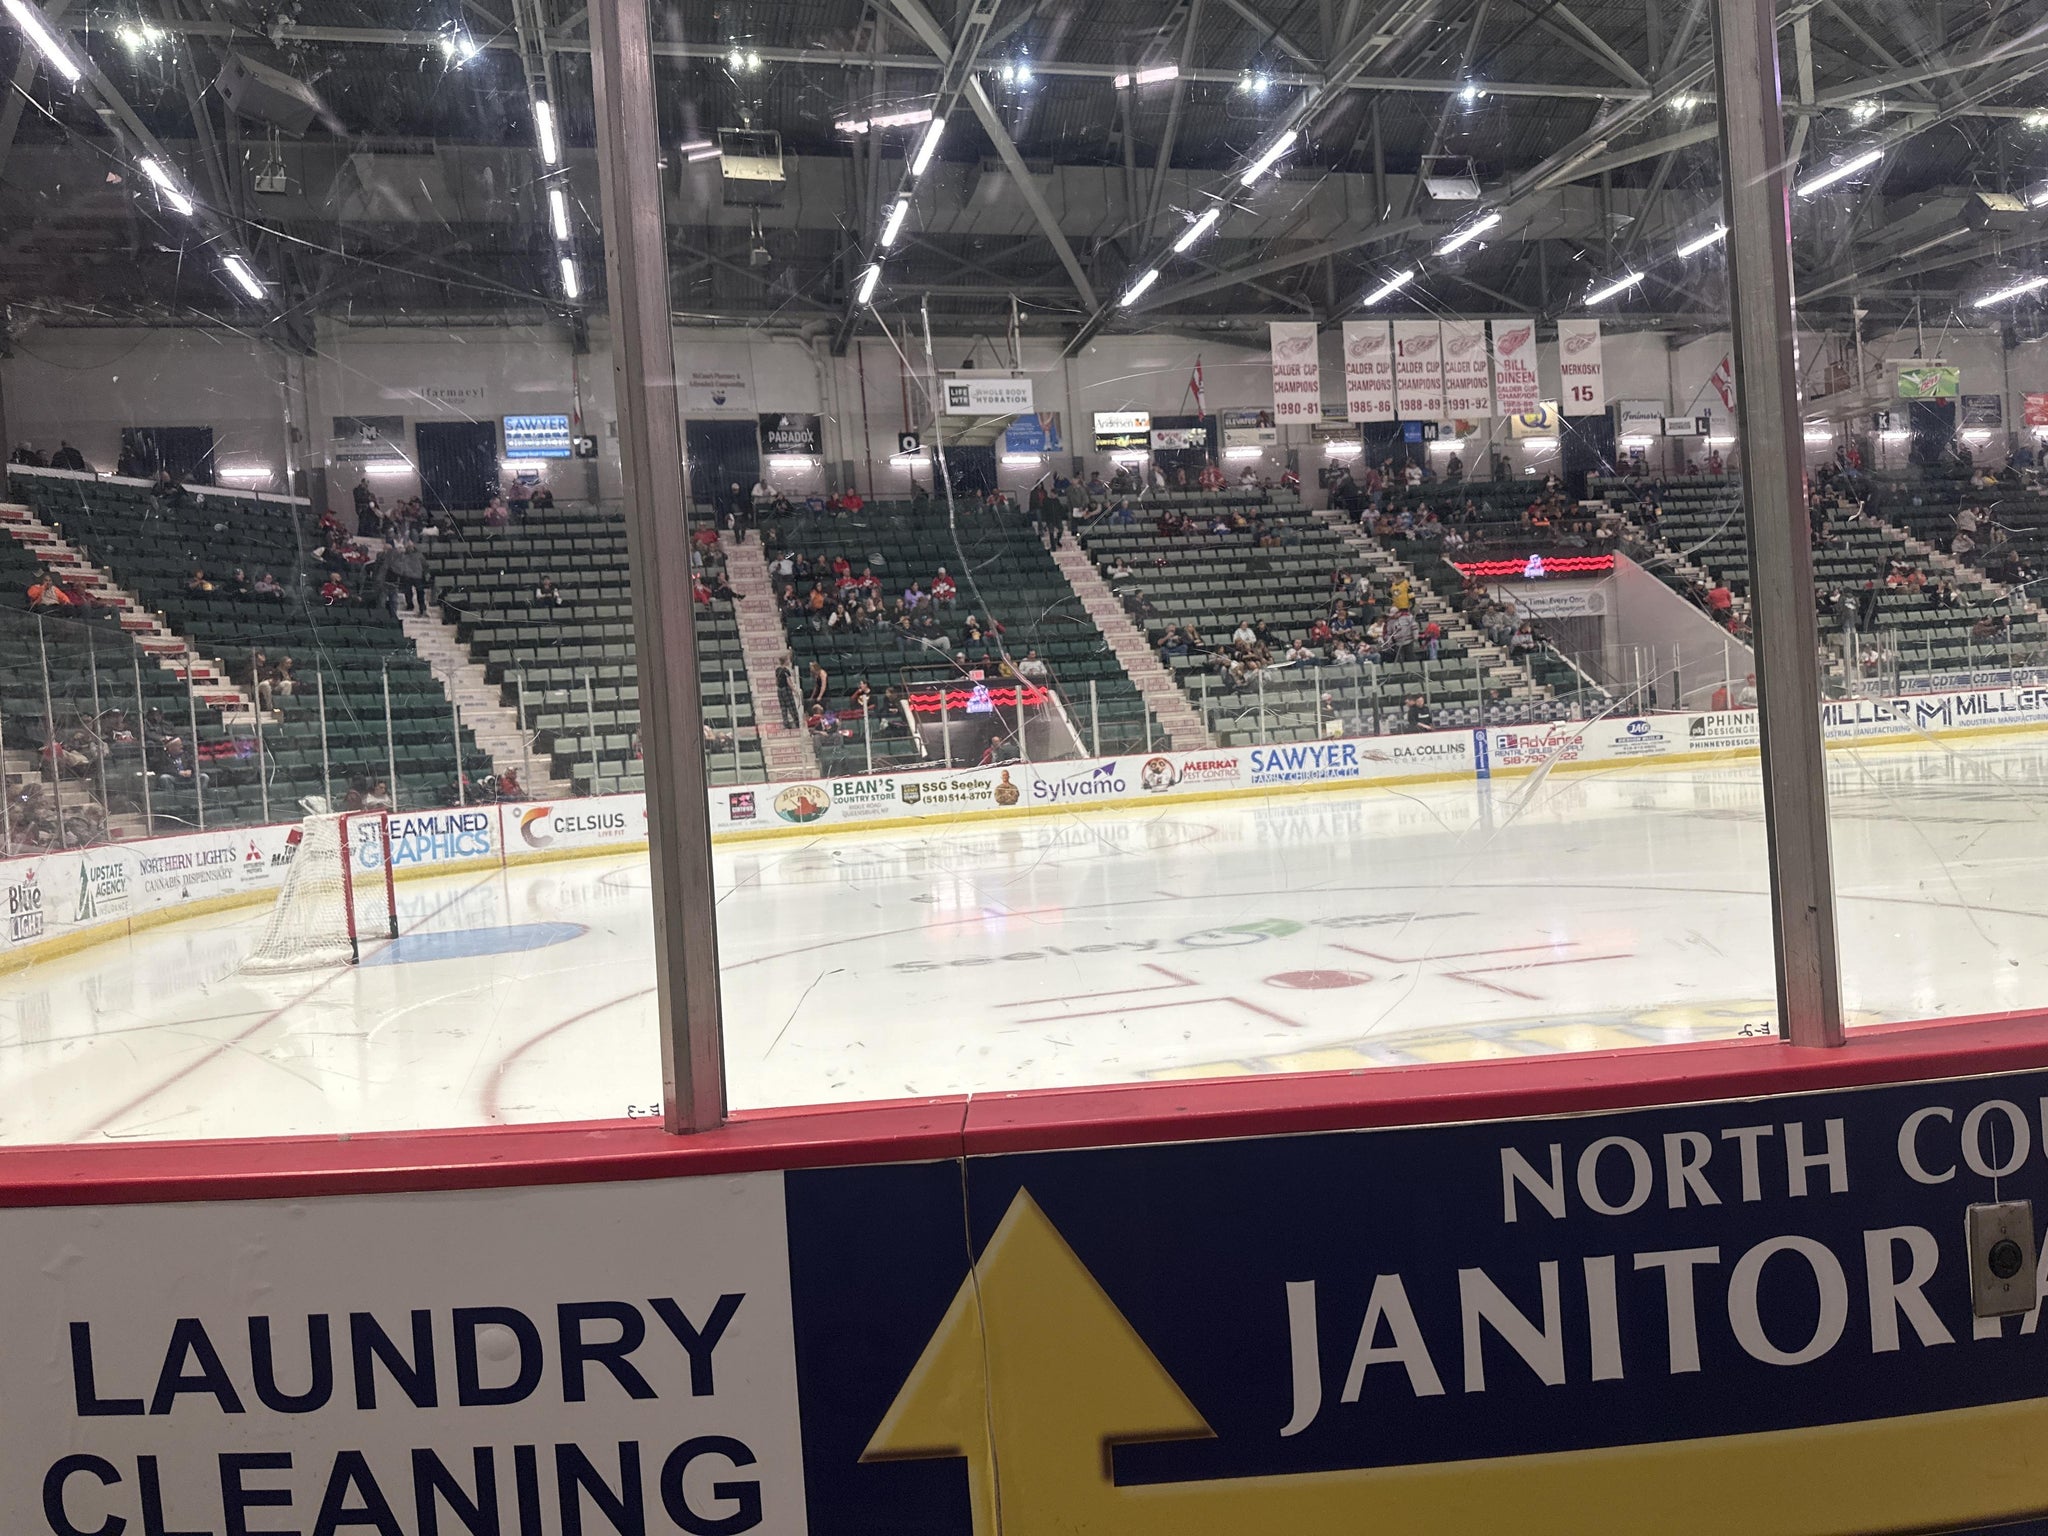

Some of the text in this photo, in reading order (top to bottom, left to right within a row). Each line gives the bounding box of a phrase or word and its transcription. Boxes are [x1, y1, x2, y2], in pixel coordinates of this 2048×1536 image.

[1273, 364, 1318, 377] CALDER CUP
[1346, 362, 1390, 375] CALDER CUP
[1397, 361, 1440, 374] CALDER CUP
[1445, 361, 1486, 373] CALDER CUP
[1503, 359, 1527, 371] BILL
[1561, 364, 1600, 376] MERKOSKY
[1398, 378, 1441, 391] CHAMPIONS
[1446, 377, 1488, 390] CHAMPIONS
[1497, 372, 1536, 384] DINEEN
[1274, 380, 1319, 393] CHAMPIONS
[1347, 379, 1391, 392] CHAMPIONS
[950, 388, 968, 397] LIFE
[1571, 385, 1594, 401] 15
[976, 395, 1028, 404] HYDRATION
[1399, 399, 1441, 411] 1988-89
[1449, 398, 1489, 410] 1991-92
[1276, 402, 1319, 415] 1980-81
[1349, 401, 1391, 413] 1985-86
[505, 417, 568, 431] SAWYER
[1698, 420, 1707, 433] L
[1878, 415, 1888, 429] K
[768, 430, 815, 443] PARADOX
[1424, 425, 1437, 439] M
[580, 438, 593, 455] P
[1956, 689, 2048, 716] MILLER
[1707, 713, 1755, 727] PHINN
[1959, 716, 1996, 727] INDUSTRIAL
[1630, 723, 1649, 734] JAG
[1707, 726, 1742, 736] DESIGN
[1825, 726, 1911, 738] USTRIAL MANUFACTURING
[1520, 735, 1583, 749] Advance
[1689, 738, 1759, 749] PHINNEYDESIGN.
[1394, 747, 1415, 757] D.A.
[1416, 743, 1465, 756] COLLINS
[1184, 758, 1239, 771] MEERKAT
[1251, 743, 1358, 773] SAWYER
[1184, 769, 1240, 780] PEST CONTROL
[1285, 767, 1359, 781] CHIROPRACTIC
[833, 778, 894, 796] BEAN'S
[922, 779, 992, 792] SSG Seeley
[1033, 776, 1126, 803] Sylvamo
[833, 794, 870, 805] COUNTRY
[871, 792, 896, 801] STORE
[922, 794, 947, 804] (518)
[554, 813, 624, 833] CELSIUS
[360, 830, 490, 868] GAPHICS
[139, 847, 237, 876] NORTHERN LIGHTS
[90, 863, 123, 882] UPSTATE
[145, 874, 181, 893] CANNABIS
[183, 867, 233, 886] DISPENSARY
[96, 878, 125, 897] AGENCY
[9, 885, 41, 914] Blue
[11, 913, 43, 941] LIGHT
[1499, 1117, 1850, 1224] NORTH
[69, 1292, 746, 1417] LAUNDRY
[42, 1435, 763, 1536] CLEANING
